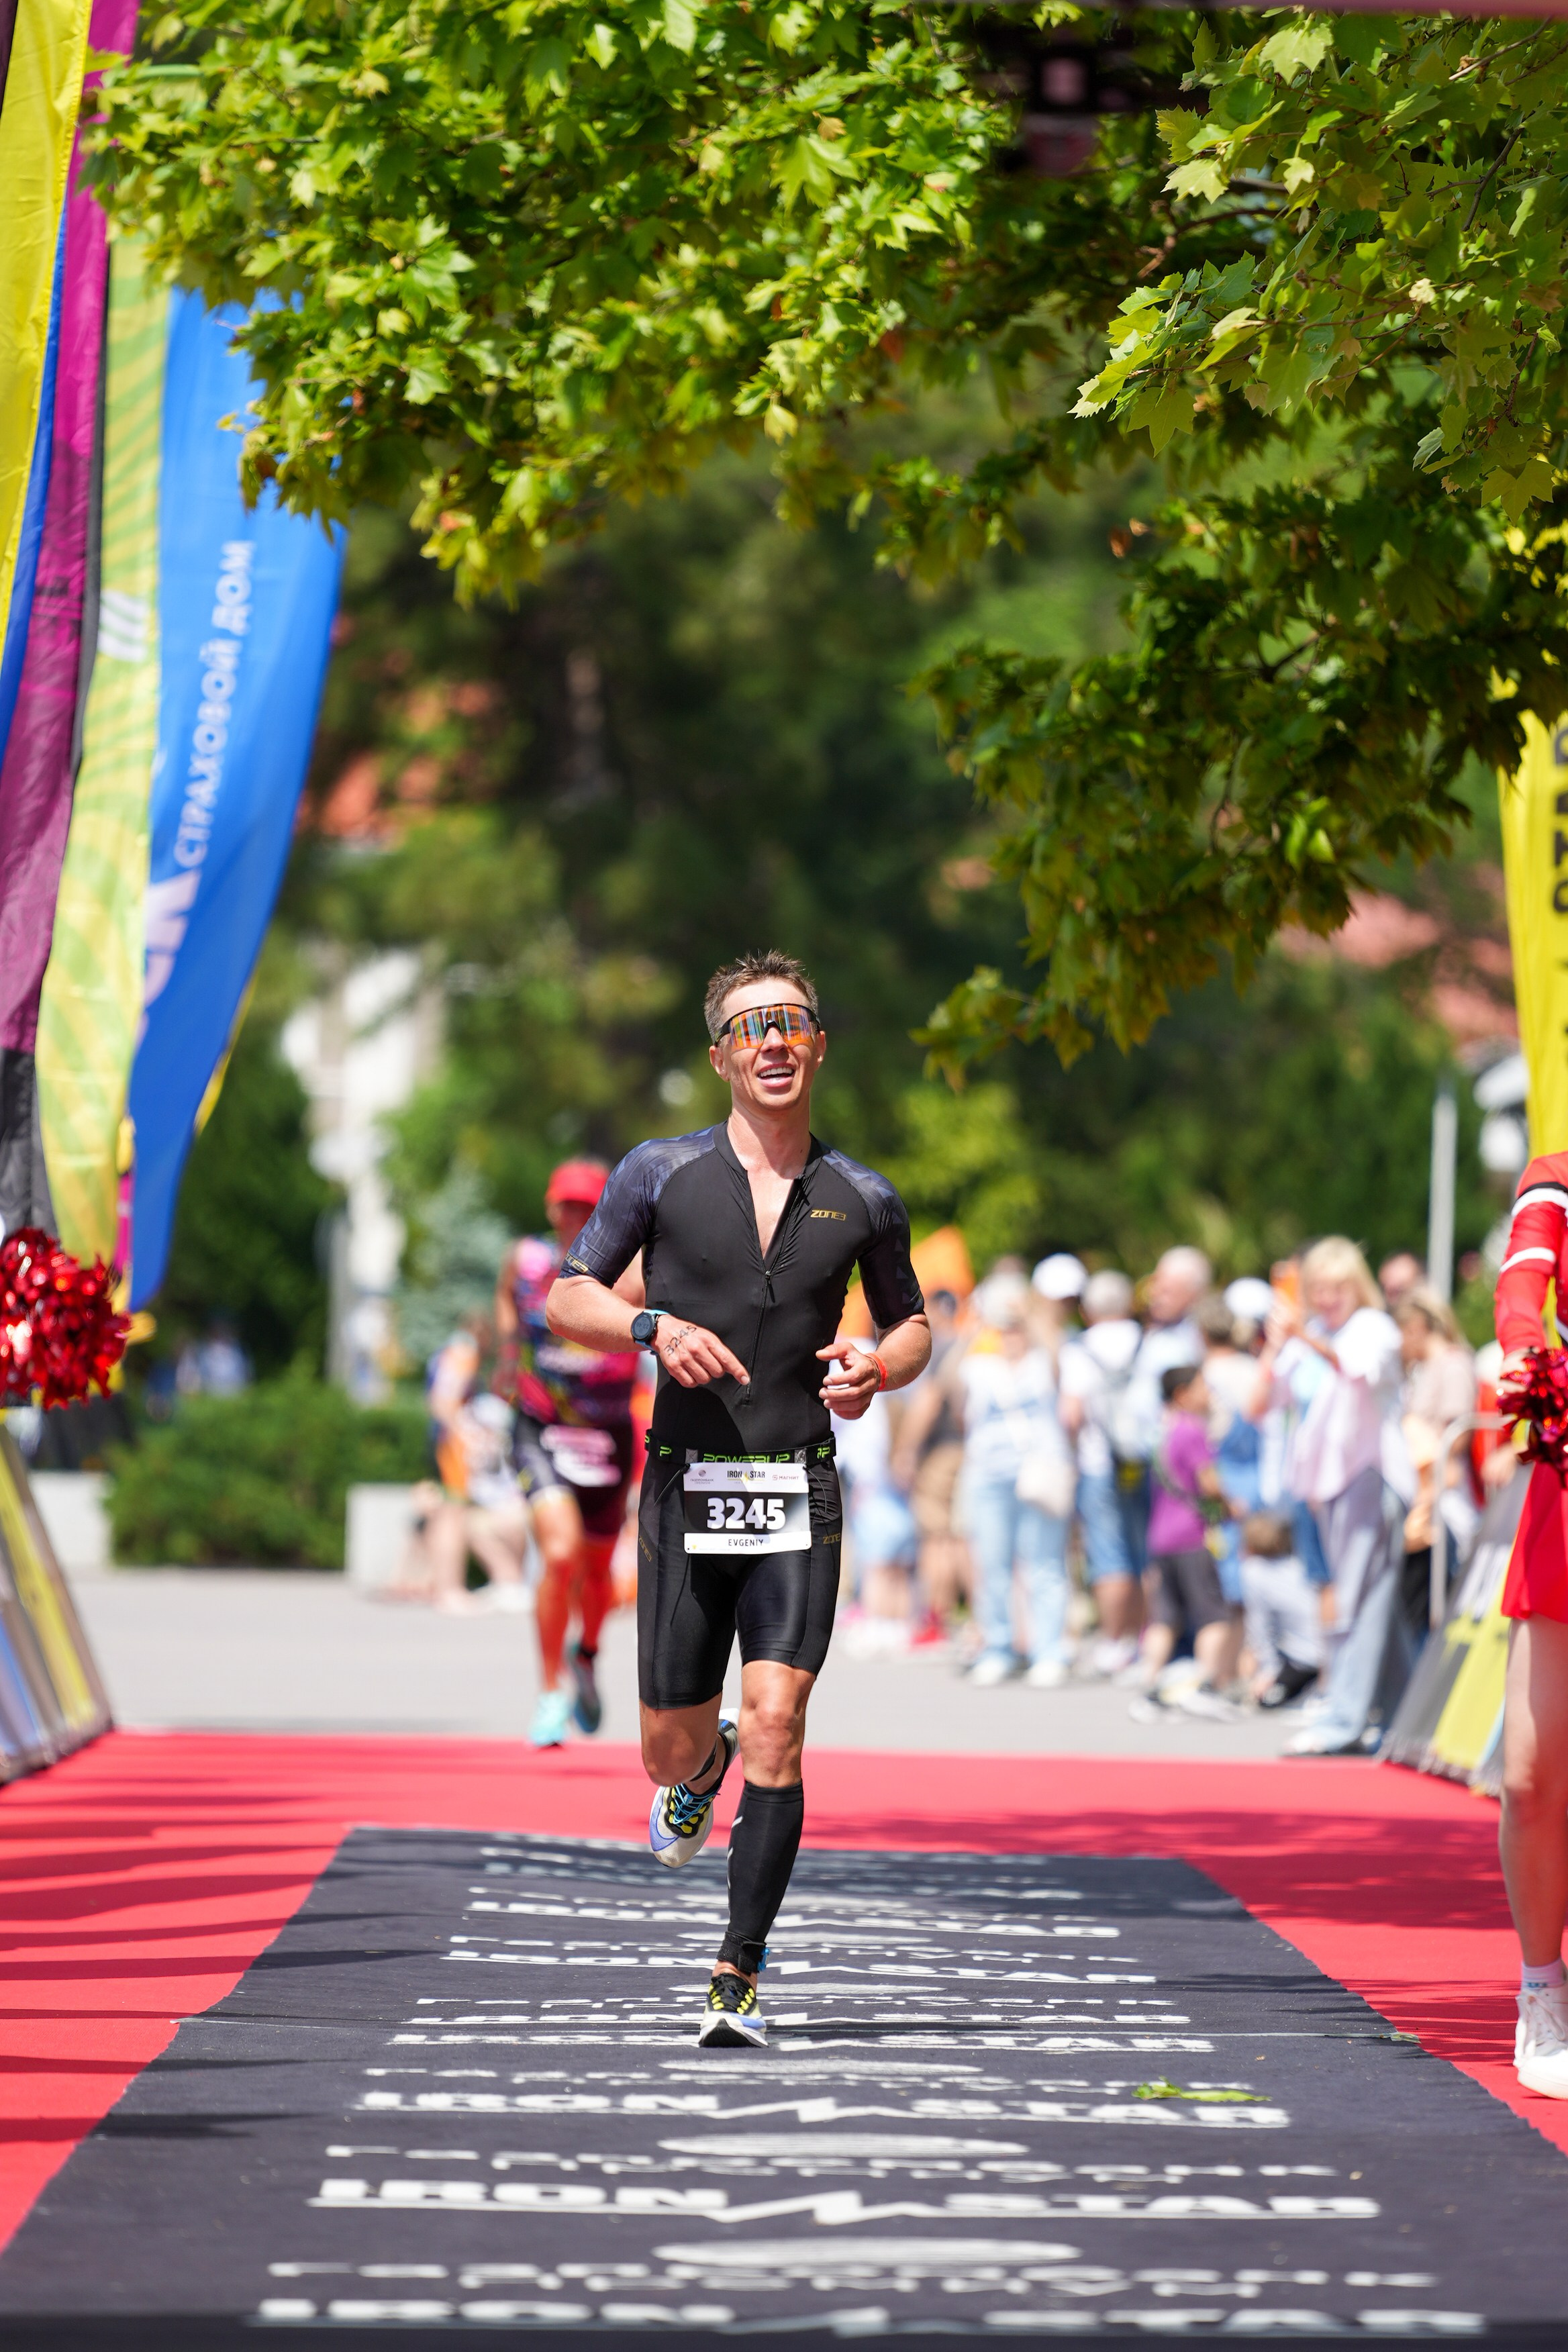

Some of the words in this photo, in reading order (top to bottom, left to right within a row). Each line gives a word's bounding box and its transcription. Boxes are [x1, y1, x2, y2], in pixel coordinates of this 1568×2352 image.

[174, 638, 242, 867] СТРАХОВОЙ
[211, 540, 256, 636] ДОМ
[664, 1325, 697, 1357] 3245
[727, 1470, 742, 1478] IRON
[750, 1471, 765, 1479] STAR
[707, 1497, 786, 1530] 3245
[728, 1538, 764, 1547] EVGENIY
[449, 1950, 720, 1965] IRON
[868, 1964, 1155, 1983] STAR
[410, 2012, 709, 2022] IRON
[872, 2014, 1191, 2022] STAR
[393, 2035, 701, 2043] IRON
[879, 2036, 1212, 2049] STAR
[363, 2092, 719, 2110] IRON
[913, 2099, 1288, 2124] STAR
[320, 2179, 728, 2208] IRON
[946, 2193, 1378, 2214] STAR
[259, 2298, 734, 2324] IRON
[984, 2308, 1480, 2335] STAR
